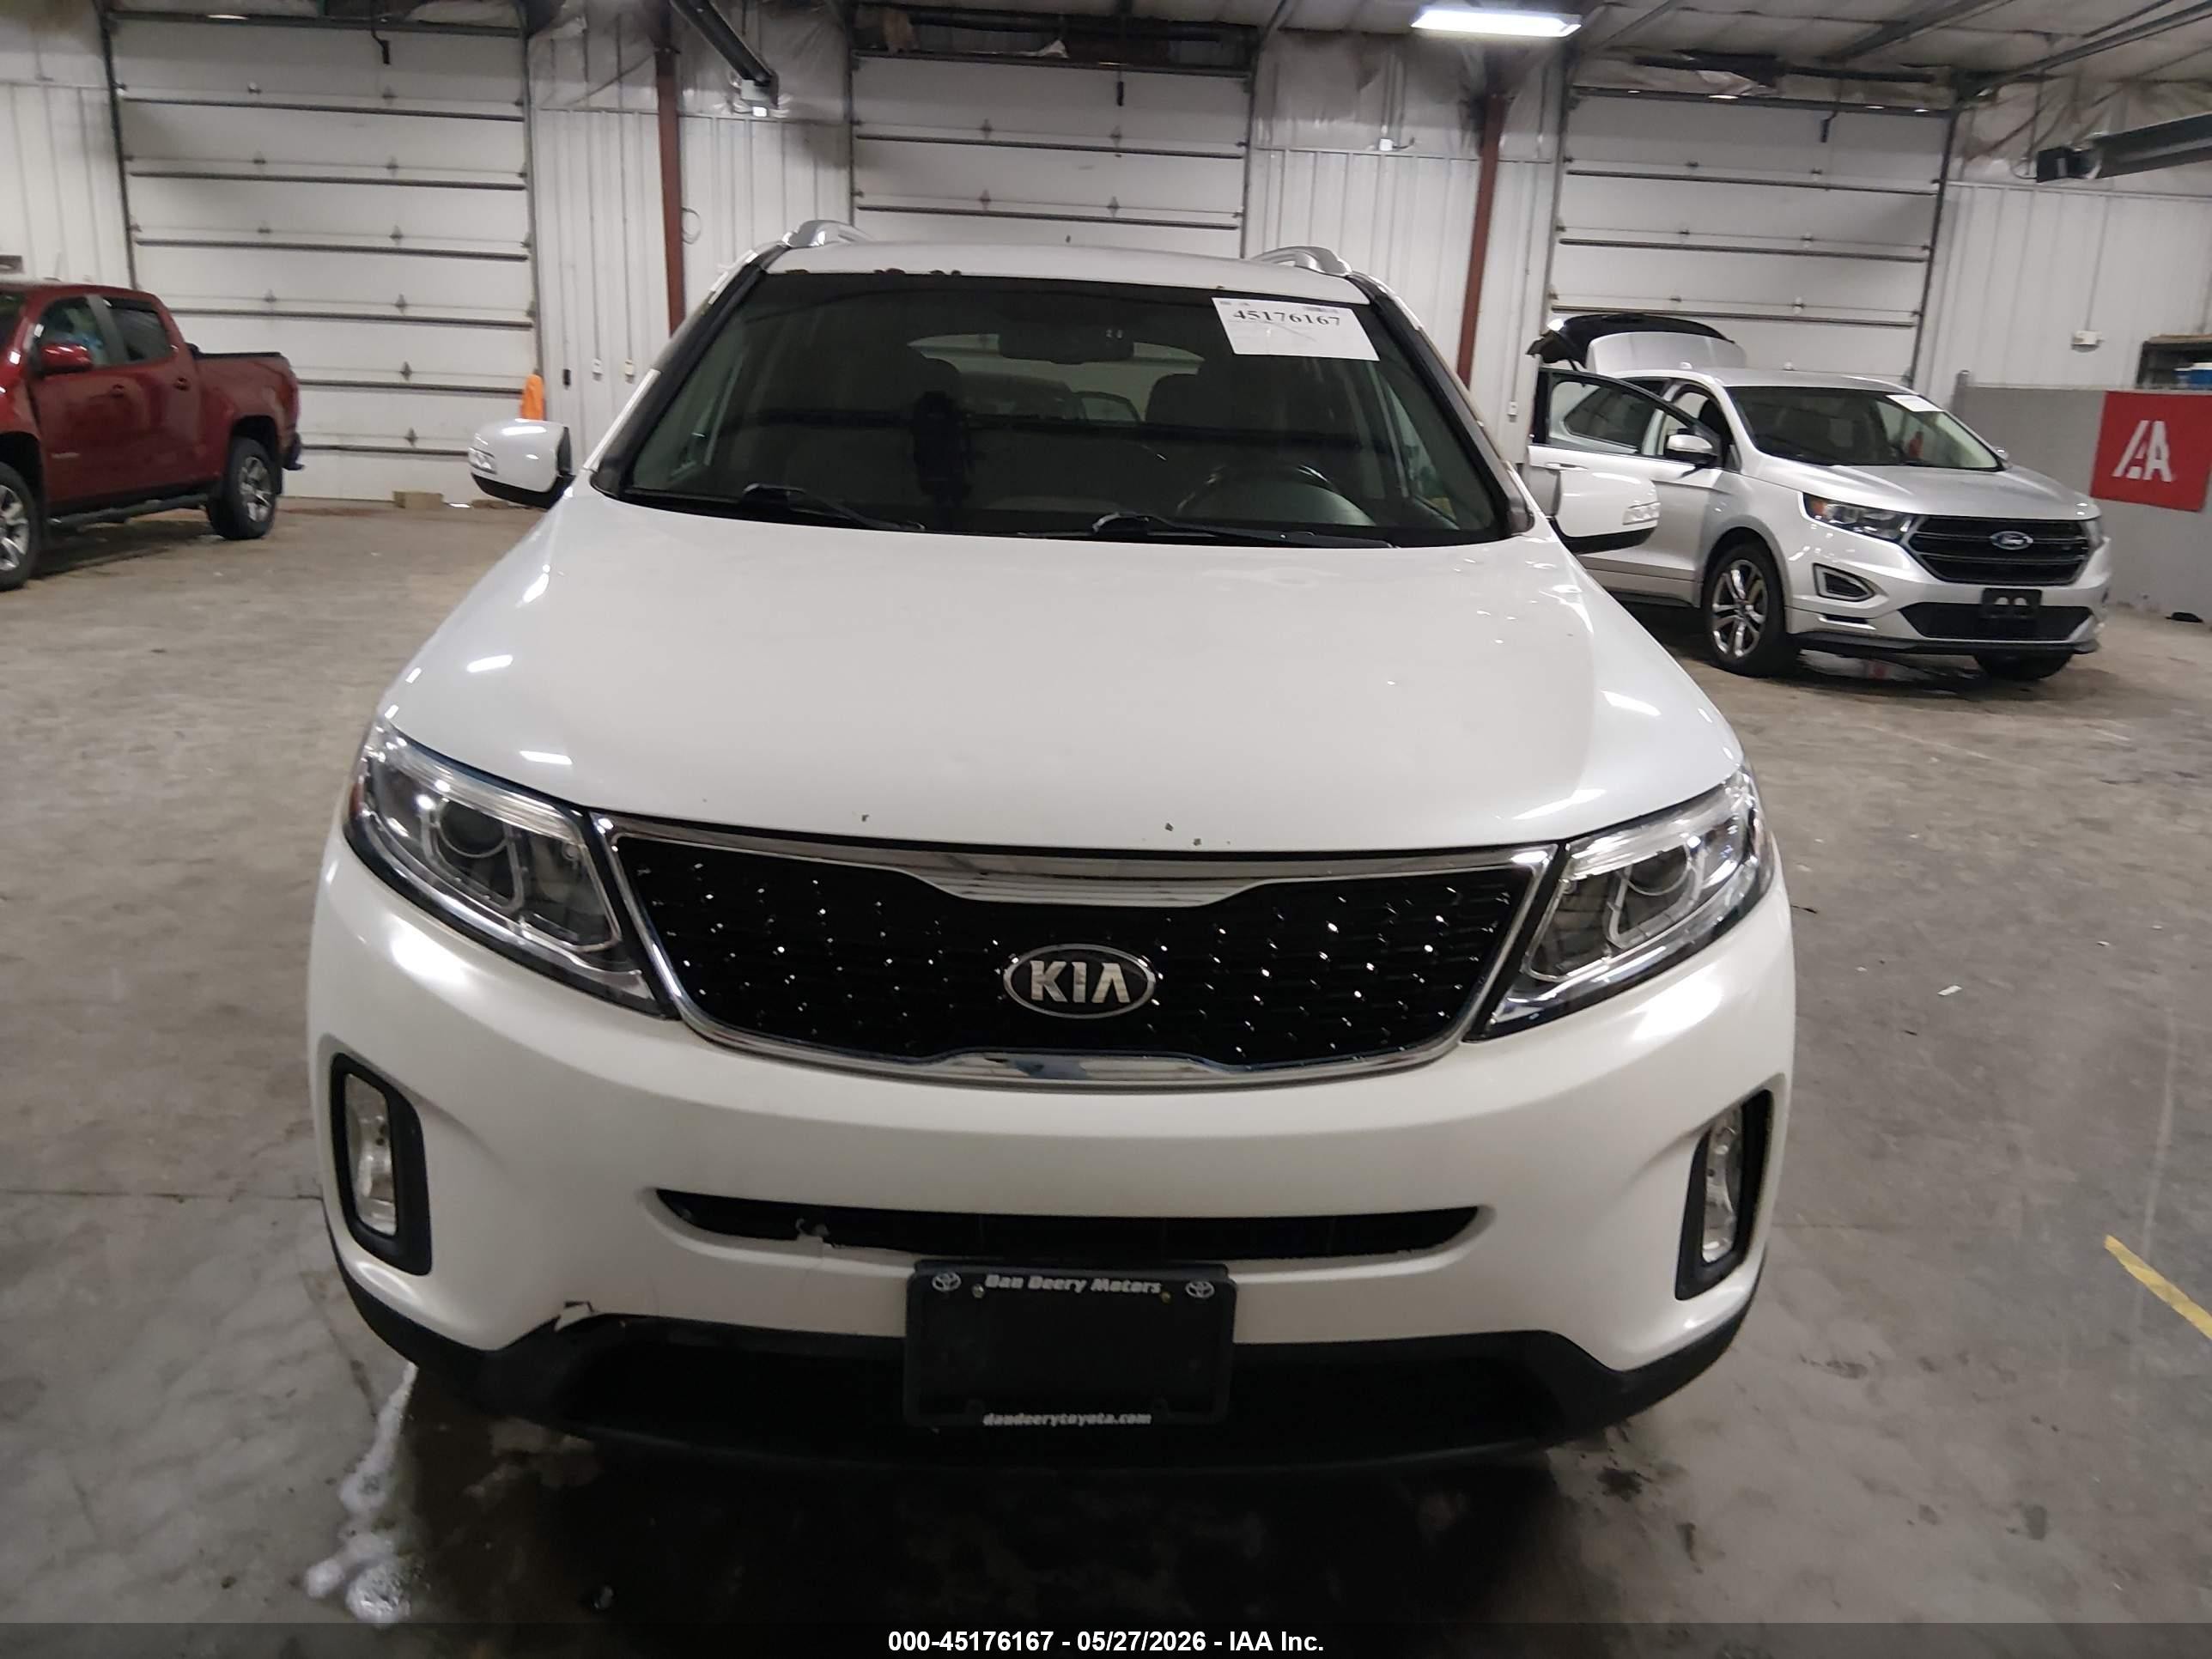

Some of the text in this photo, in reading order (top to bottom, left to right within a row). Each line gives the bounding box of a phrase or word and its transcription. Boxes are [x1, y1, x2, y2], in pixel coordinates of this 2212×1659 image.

[1233, 309, 1340, 326] 45176167
[1030, 959, 1131, 1004] KIA
[1028, 1274, 1087, 1293] Deery
[1090, 1277, 1162, 1293] Motors
